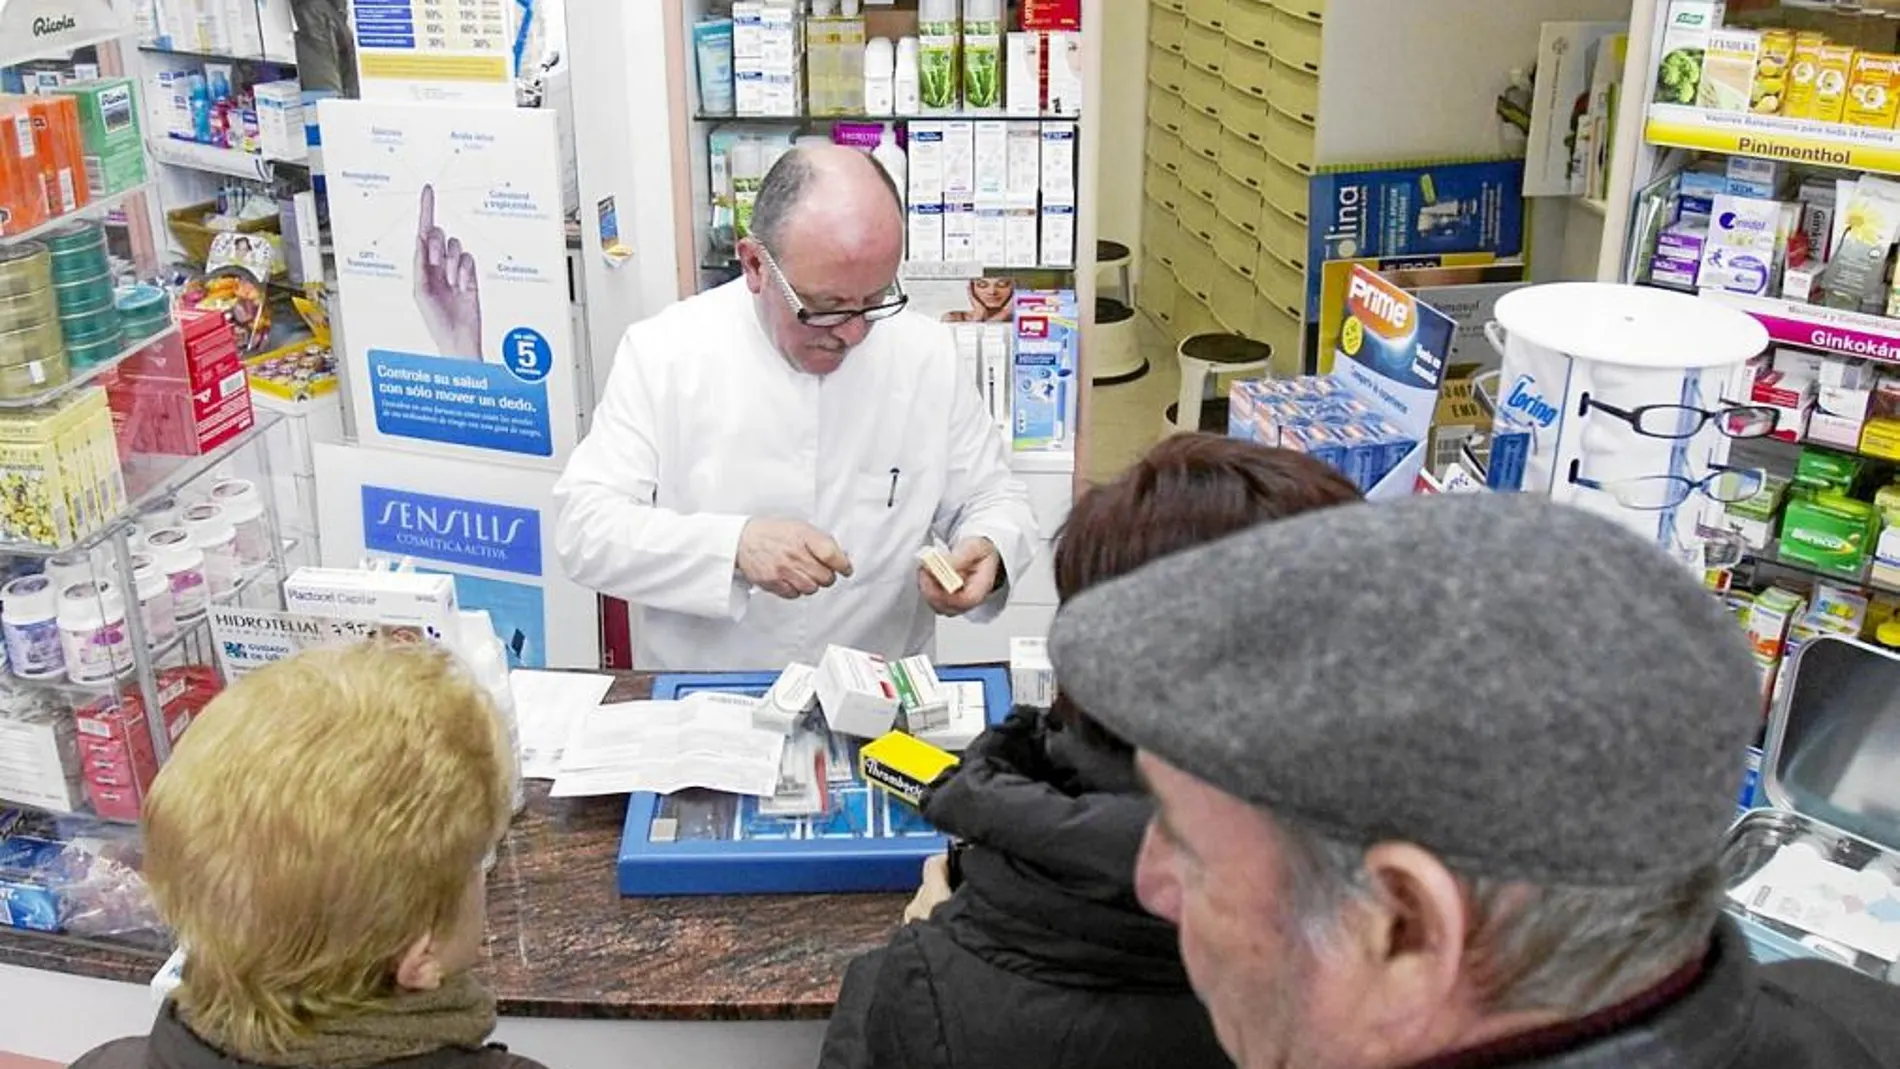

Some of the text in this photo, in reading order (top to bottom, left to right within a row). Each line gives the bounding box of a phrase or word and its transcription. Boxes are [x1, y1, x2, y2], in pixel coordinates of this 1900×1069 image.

[33, 15, 76, 36] Ricola
[1738, 137, 1850, 164] Pinimenthol
[1350, 275, 1409, 329] Prime
[516, 340, 538, 368] 5
[1810, 329, 1900, 359] Ginkokán
[376, 364, 489, 390] Controle su salud
[378, 382, 538, 412] con sólo mover un dedo.
[377, 500, 525, 545] SENSILIS
[464, 543, 509, 560] ACTIVA
[215, 613, 319, 637] HIDROTELIAL
[866, 758, 924, 797] Thromboci
